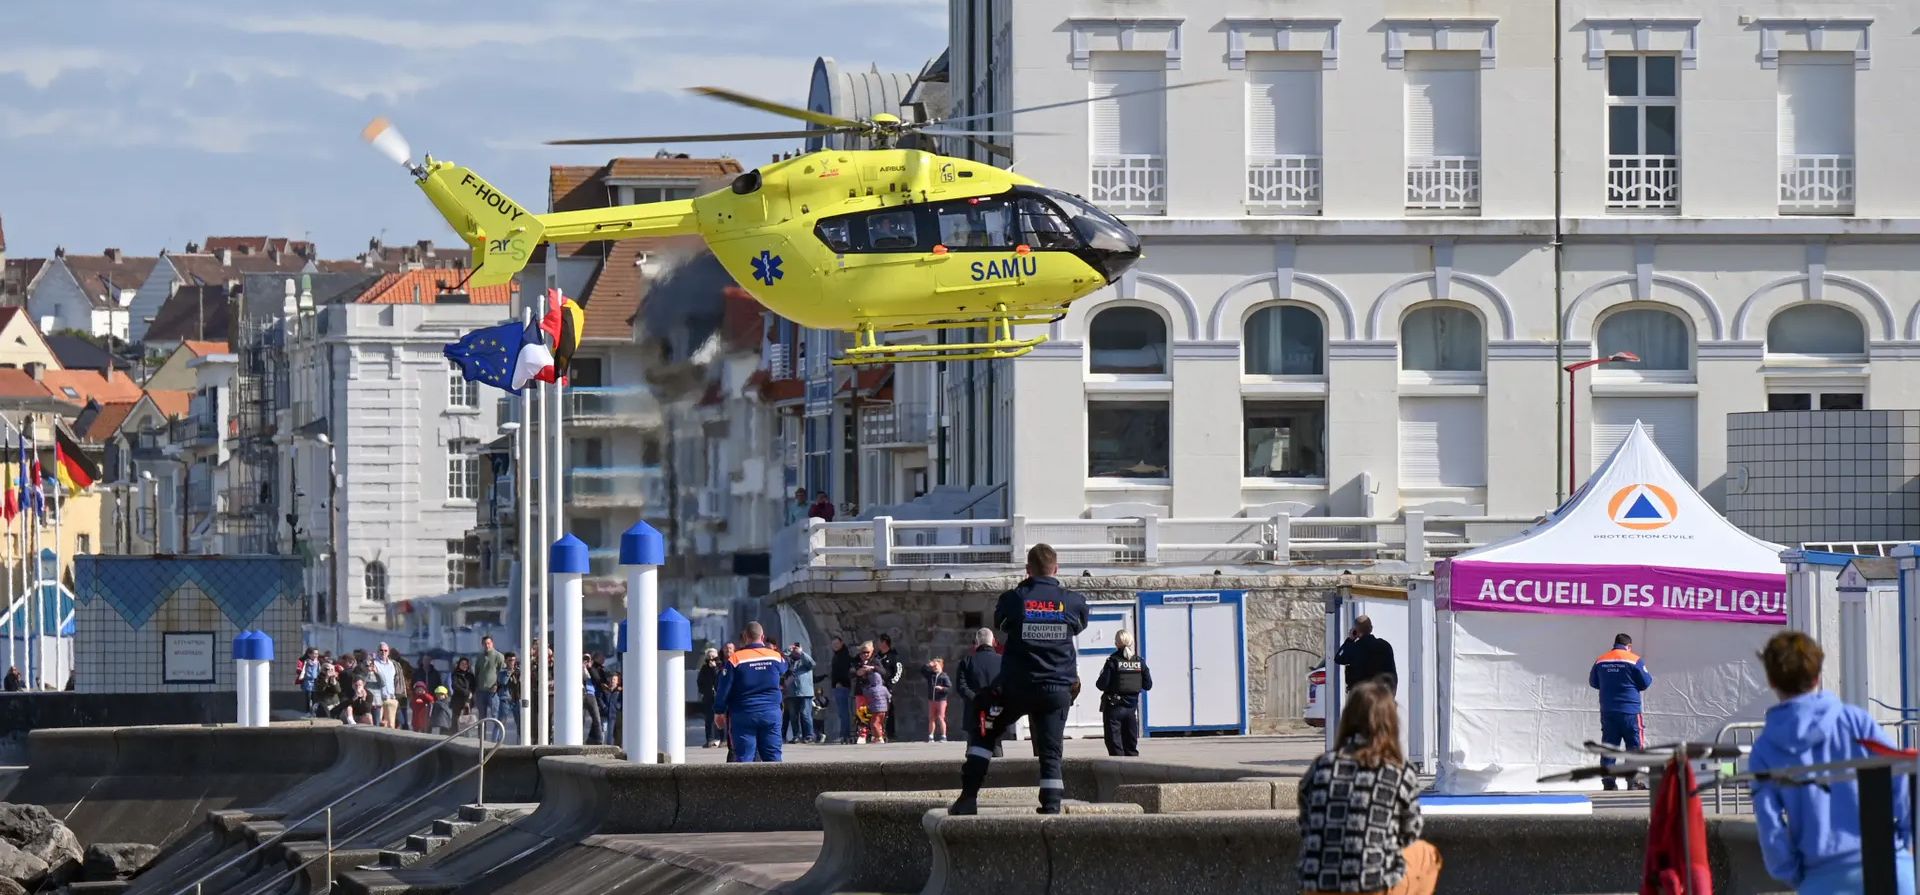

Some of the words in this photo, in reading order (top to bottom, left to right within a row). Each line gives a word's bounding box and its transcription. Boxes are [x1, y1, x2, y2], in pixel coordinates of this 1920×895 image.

[943, 173, 953, 182] 15
[461, 174, 523, 221] F-HOUY
[971, 256, 1037, 281] SAMU
[1478, 578, 1594, 605] ACCUEIL
[1602, 583, 1655, 607] DES
[1663, 586, 1786, 616] IMPLIQU
[1118, 661, 1141, 669] POLICE
